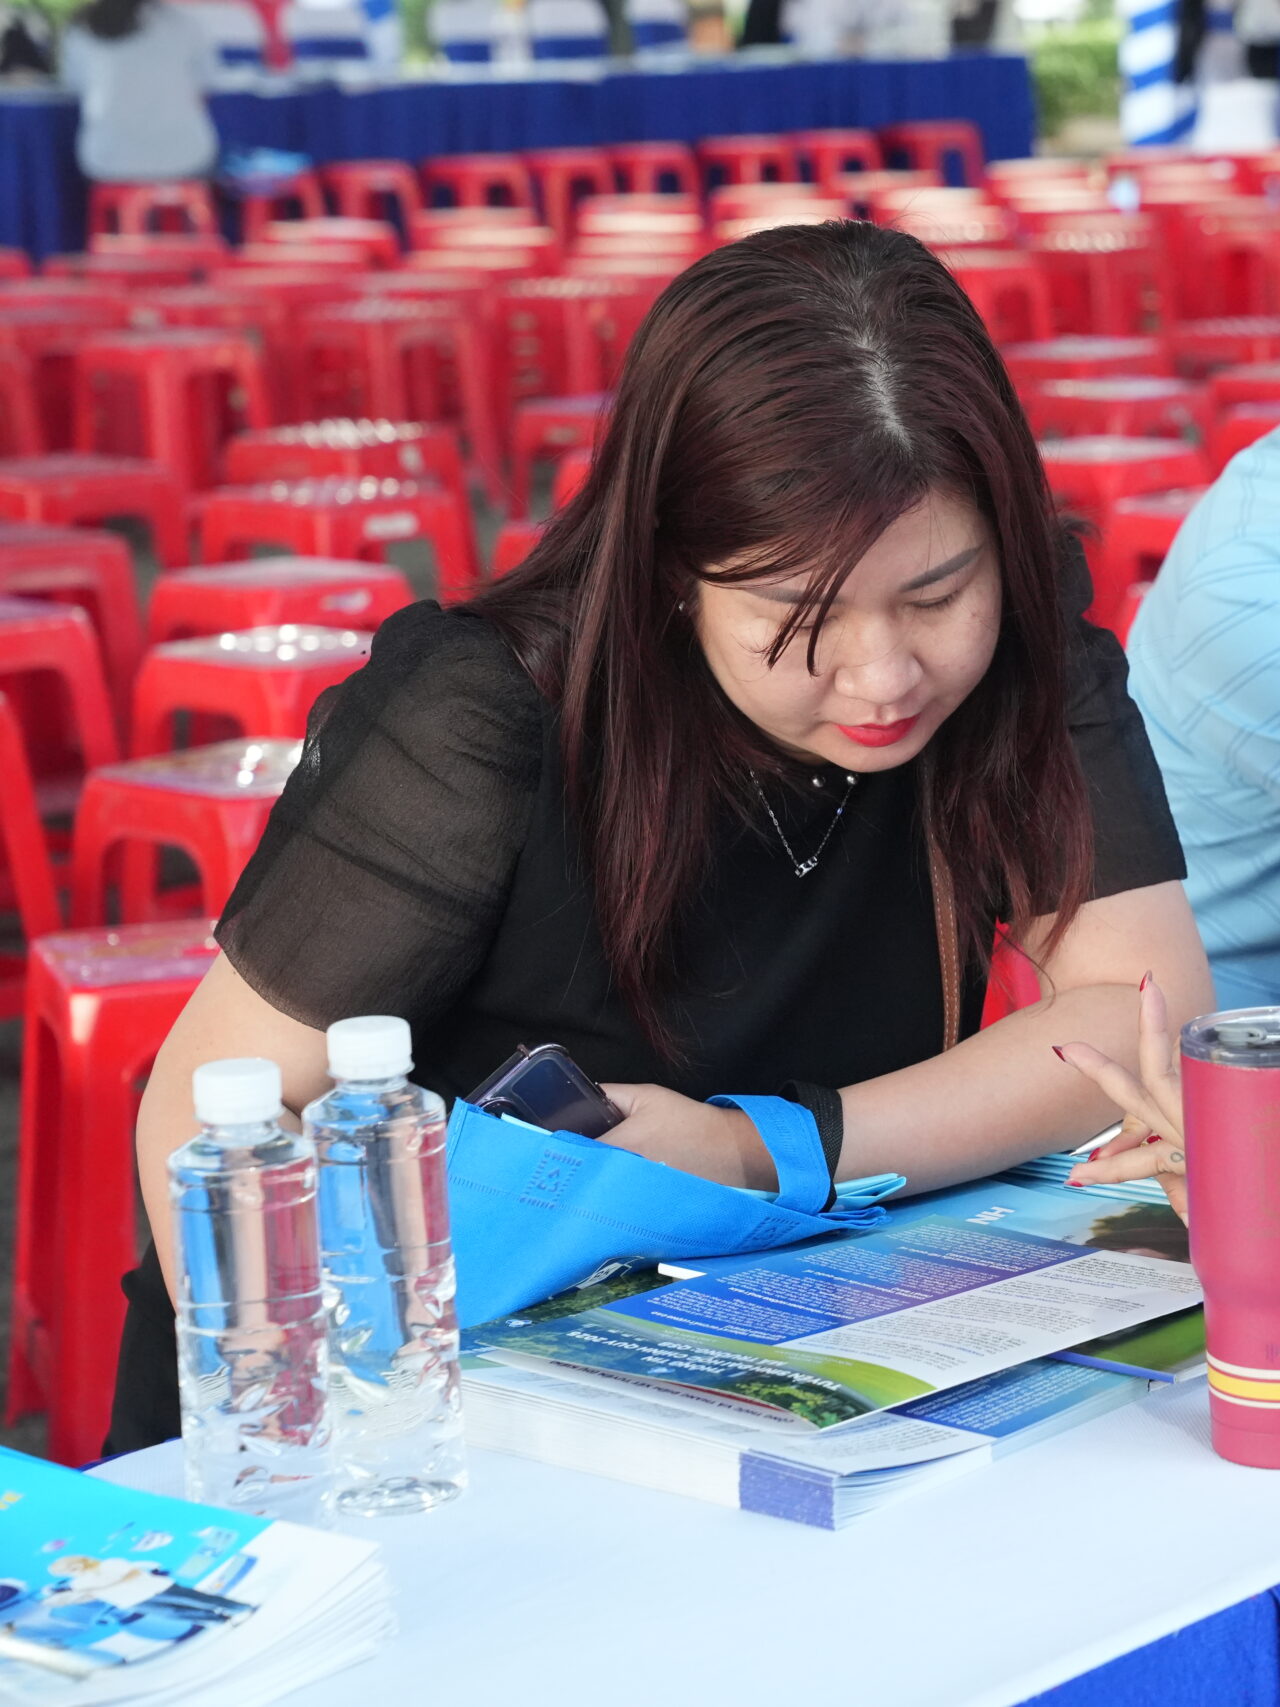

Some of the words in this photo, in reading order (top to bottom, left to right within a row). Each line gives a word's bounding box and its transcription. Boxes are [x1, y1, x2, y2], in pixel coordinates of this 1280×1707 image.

[965, 1206, 1016, 1225] NH
[566, 1331, 608, 1342] 2025
[641, 1356, 670, 1364] TIN
[787, 1373, 842, 1391] TUYỂN
